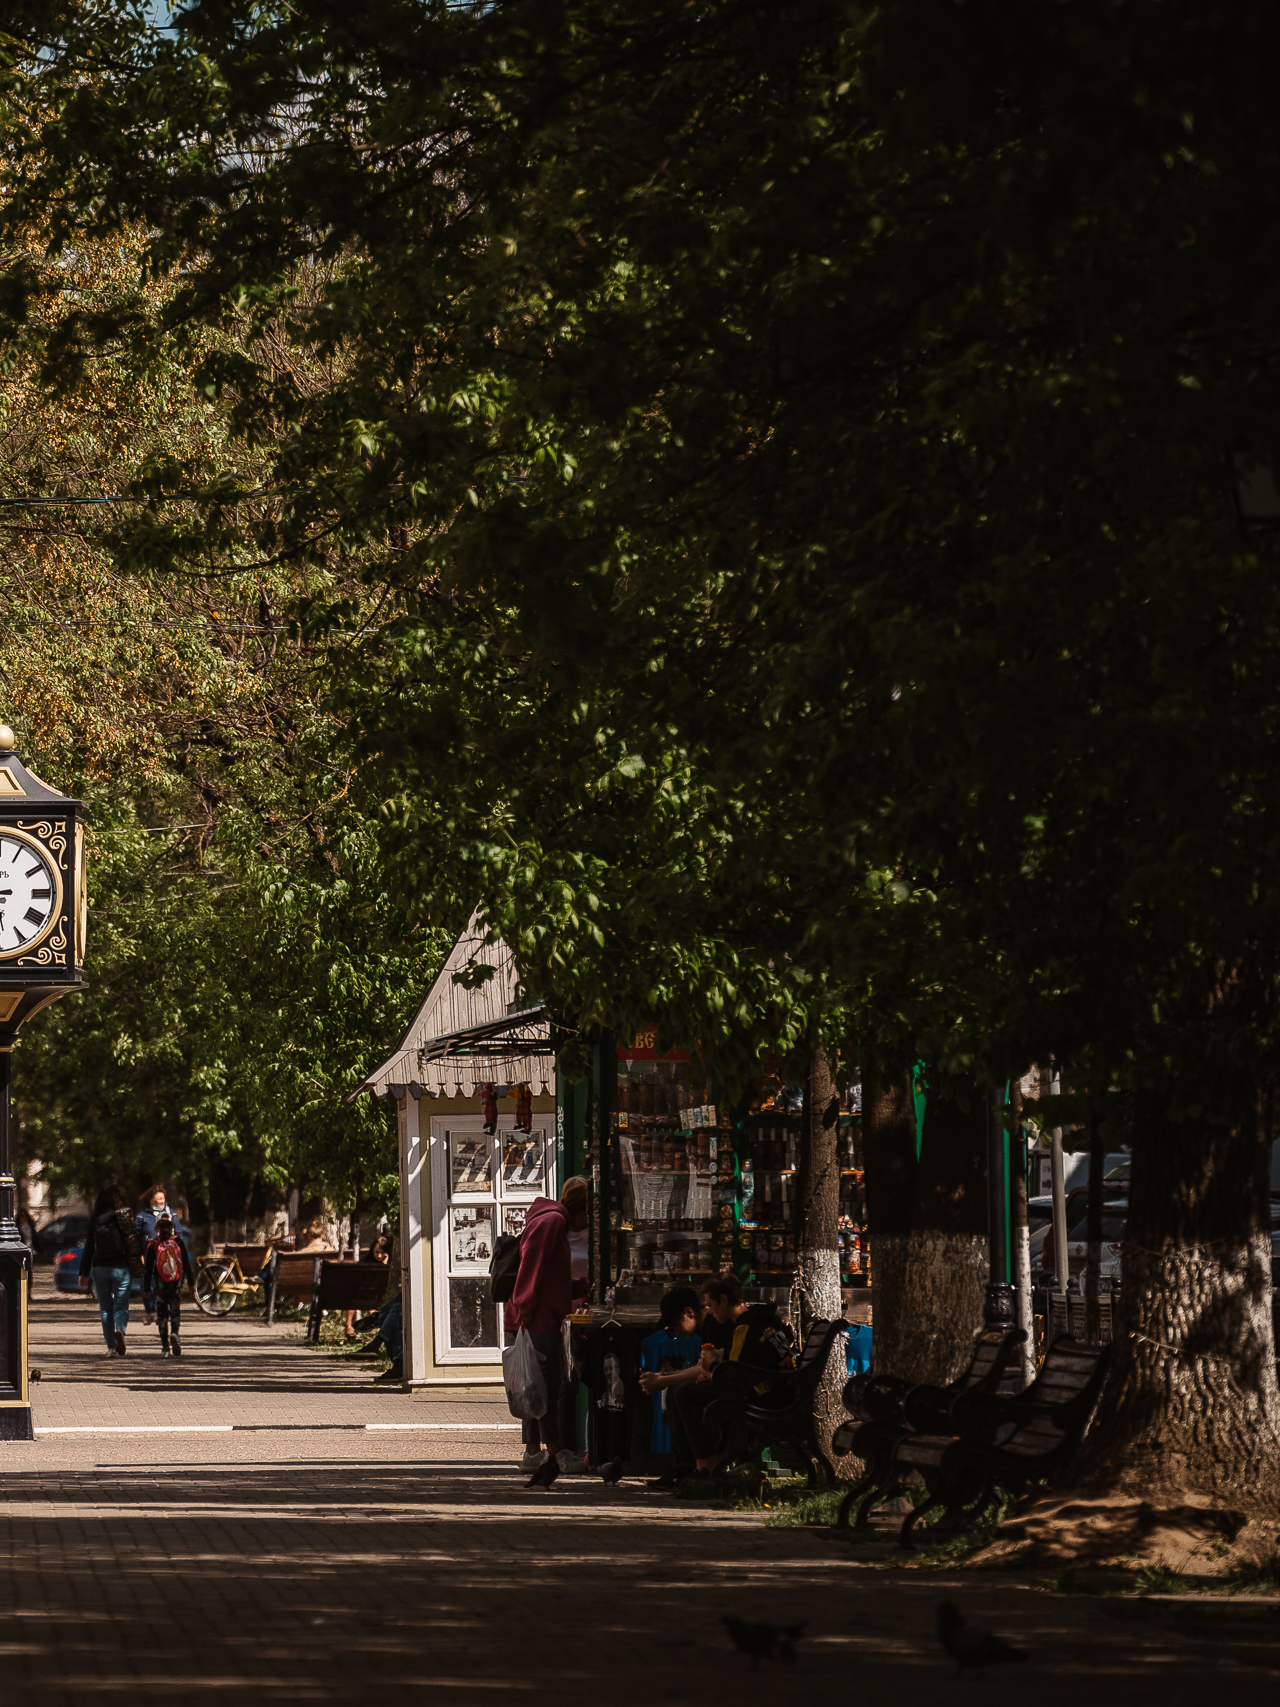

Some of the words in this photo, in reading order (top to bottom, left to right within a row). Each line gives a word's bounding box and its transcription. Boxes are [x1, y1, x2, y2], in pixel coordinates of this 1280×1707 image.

[12, 845, 26, 863] I
[25, 863, 46, 878] II
[31, 888, 51, 901] III
